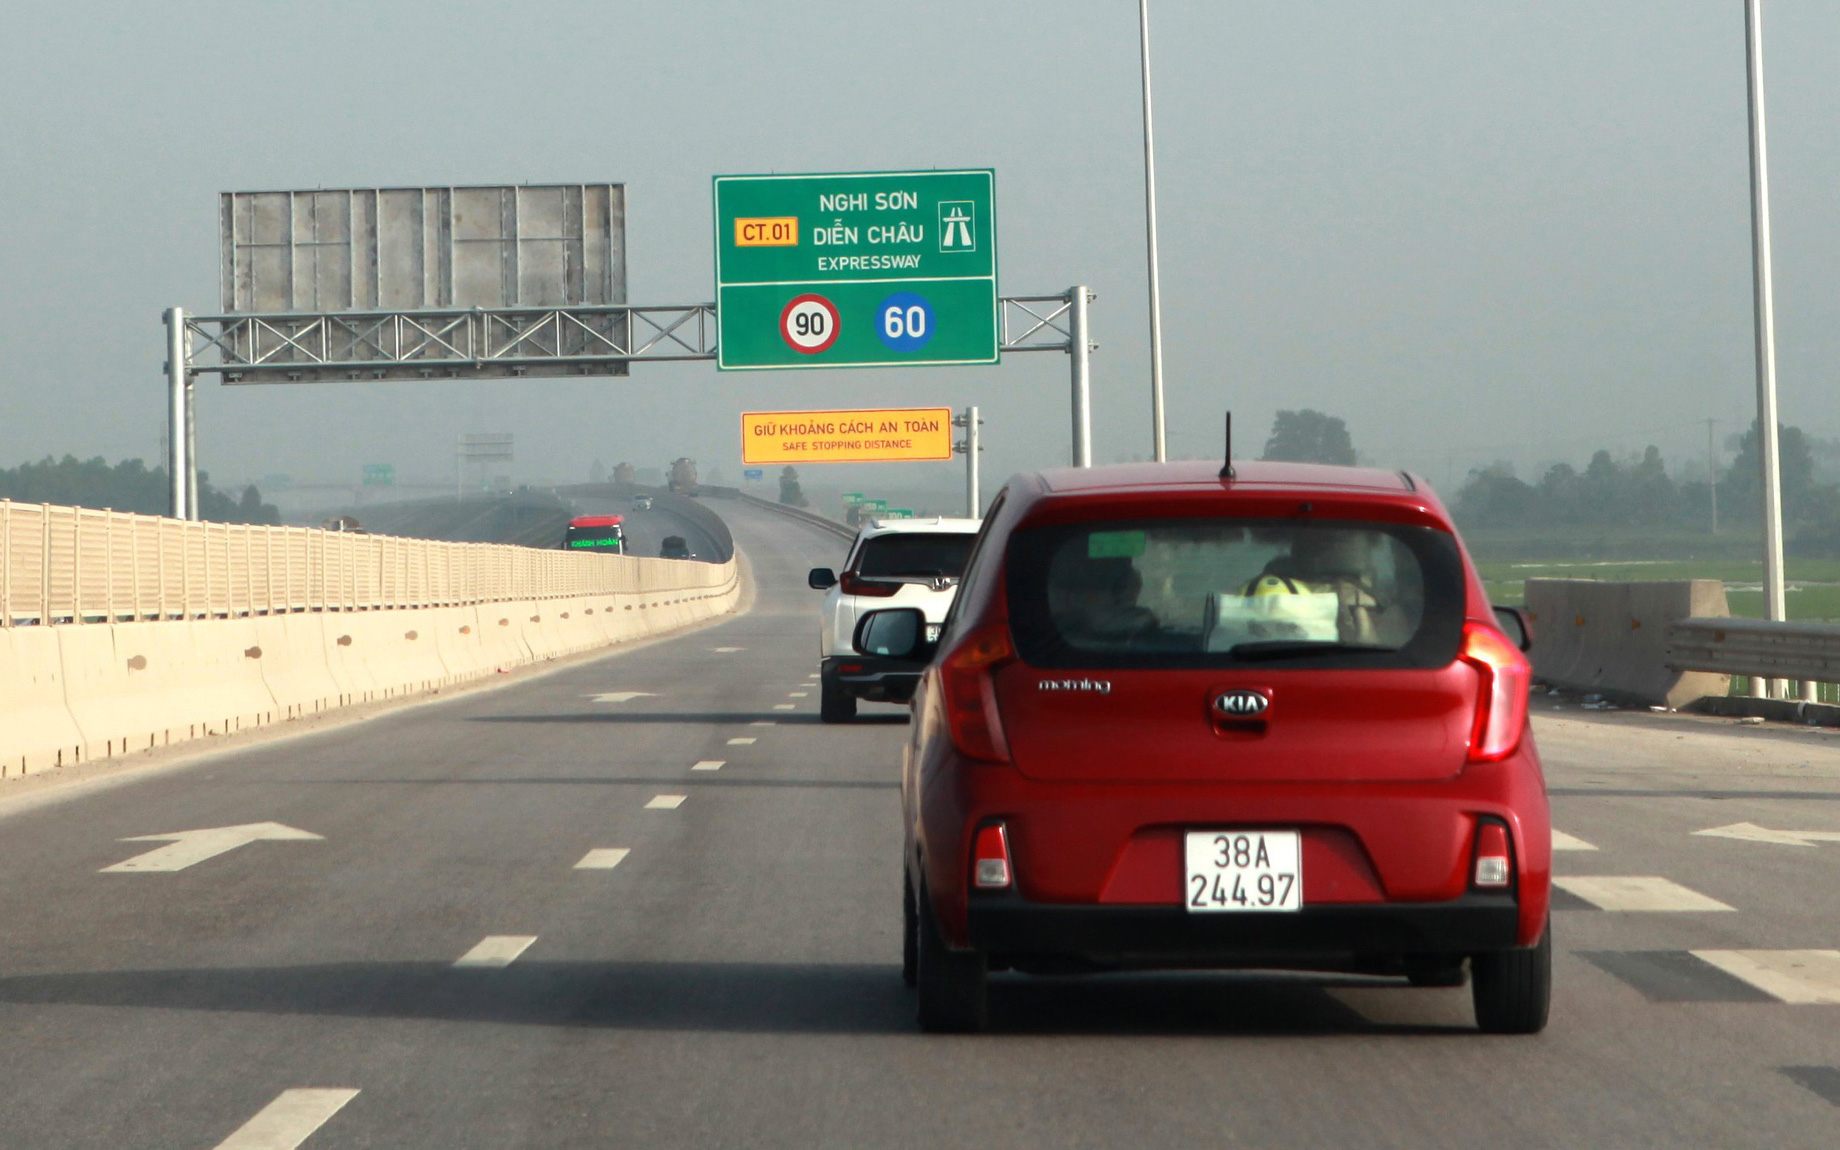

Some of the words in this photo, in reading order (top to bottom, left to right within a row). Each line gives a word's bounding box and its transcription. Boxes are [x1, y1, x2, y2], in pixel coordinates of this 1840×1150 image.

[820, 193, 868, 212] NGHI
[875, 190, 918, 210] SƠN
[743, 223, 790, 241] CT.01
[813, 218, 858, 245] DIỄN
[867, 221, 924, 244] CHÂU
[818, 254, 921, 271] EXPRESSWAY
[796, 312, 825, 336] 90
[884, 305, 926, 338] 60
[754, 421, 776, 436] GIỮ
[780, 419, 835, 436] KHOẢNG
[839, 419, 873, 434] CÁCH
[879, 421, 898, 433] AN
[904, 417, 939, 432] TOÀN
[782, 441, 807, 451] SAFE
[812, 441, 862, 450] STOPPING
[864, 439, 912, 449] DISTANCE
[888, 512, 903, 520] 100
[1223, 695, 1260, 712] KIA
[1213, 834, 1271, 869] 38A
[1190, 872, 1296, 908] 244.97
